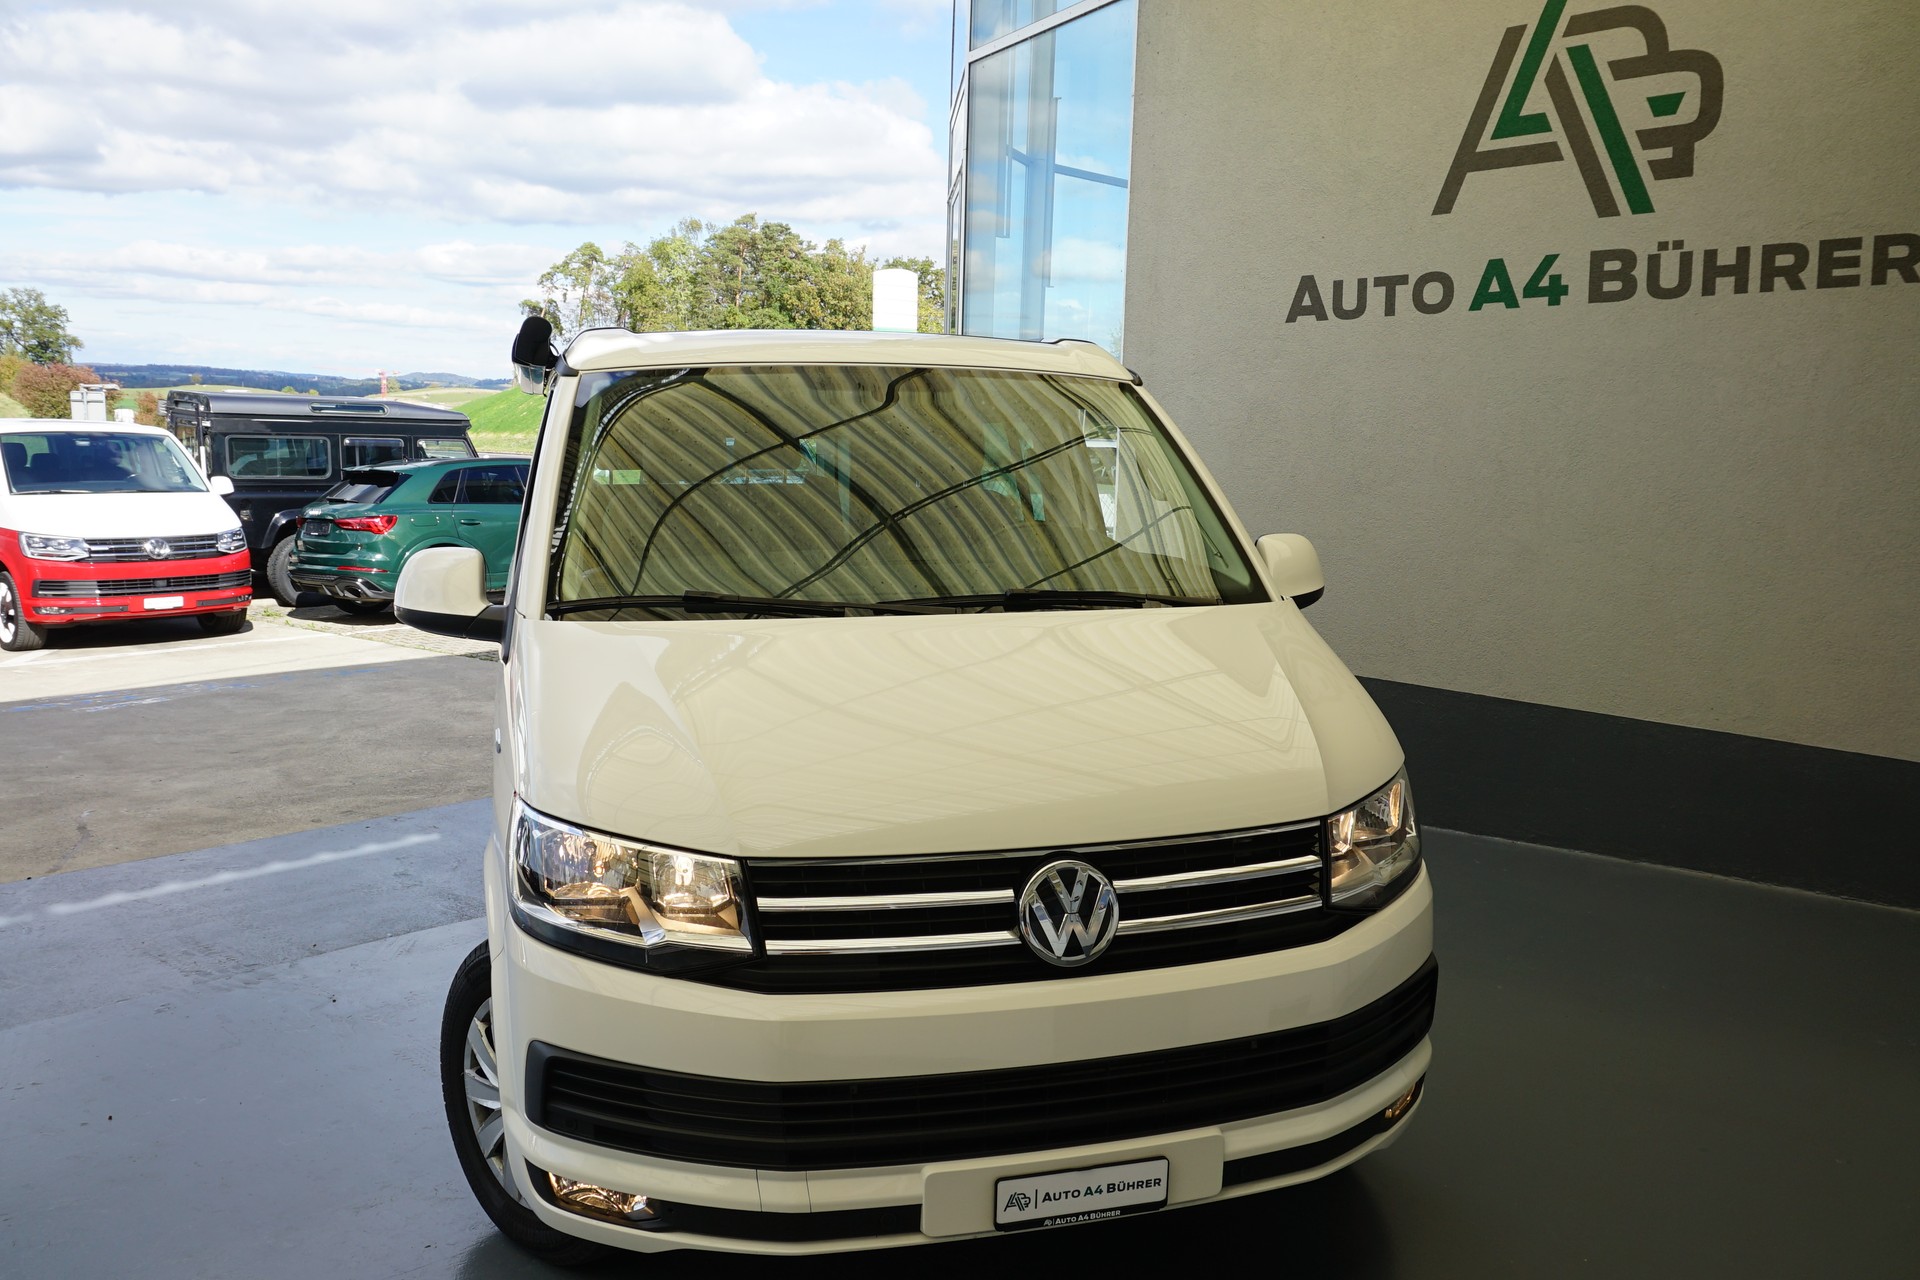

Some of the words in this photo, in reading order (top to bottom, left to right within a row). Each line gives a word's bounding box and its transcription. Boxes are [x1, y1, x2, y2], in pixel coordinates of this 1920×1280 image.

[1285, 270, 1455, 323] AUTO
[1467, 253, 1569, 311] A4
[1587, 232, 1920, 304] BÜHRER
[1042, 1189, 1081, 1203] AUTO
[1084, 1184, 1103, 1197] A4
[1106, 1178, 1161, 1193] BÜHRER
[1055, 1215, 1077, 1225] AUTO
[1078, 1213, 1089, 1221] A4
[1090, 1210, 1121, 1219] BÜHRER
